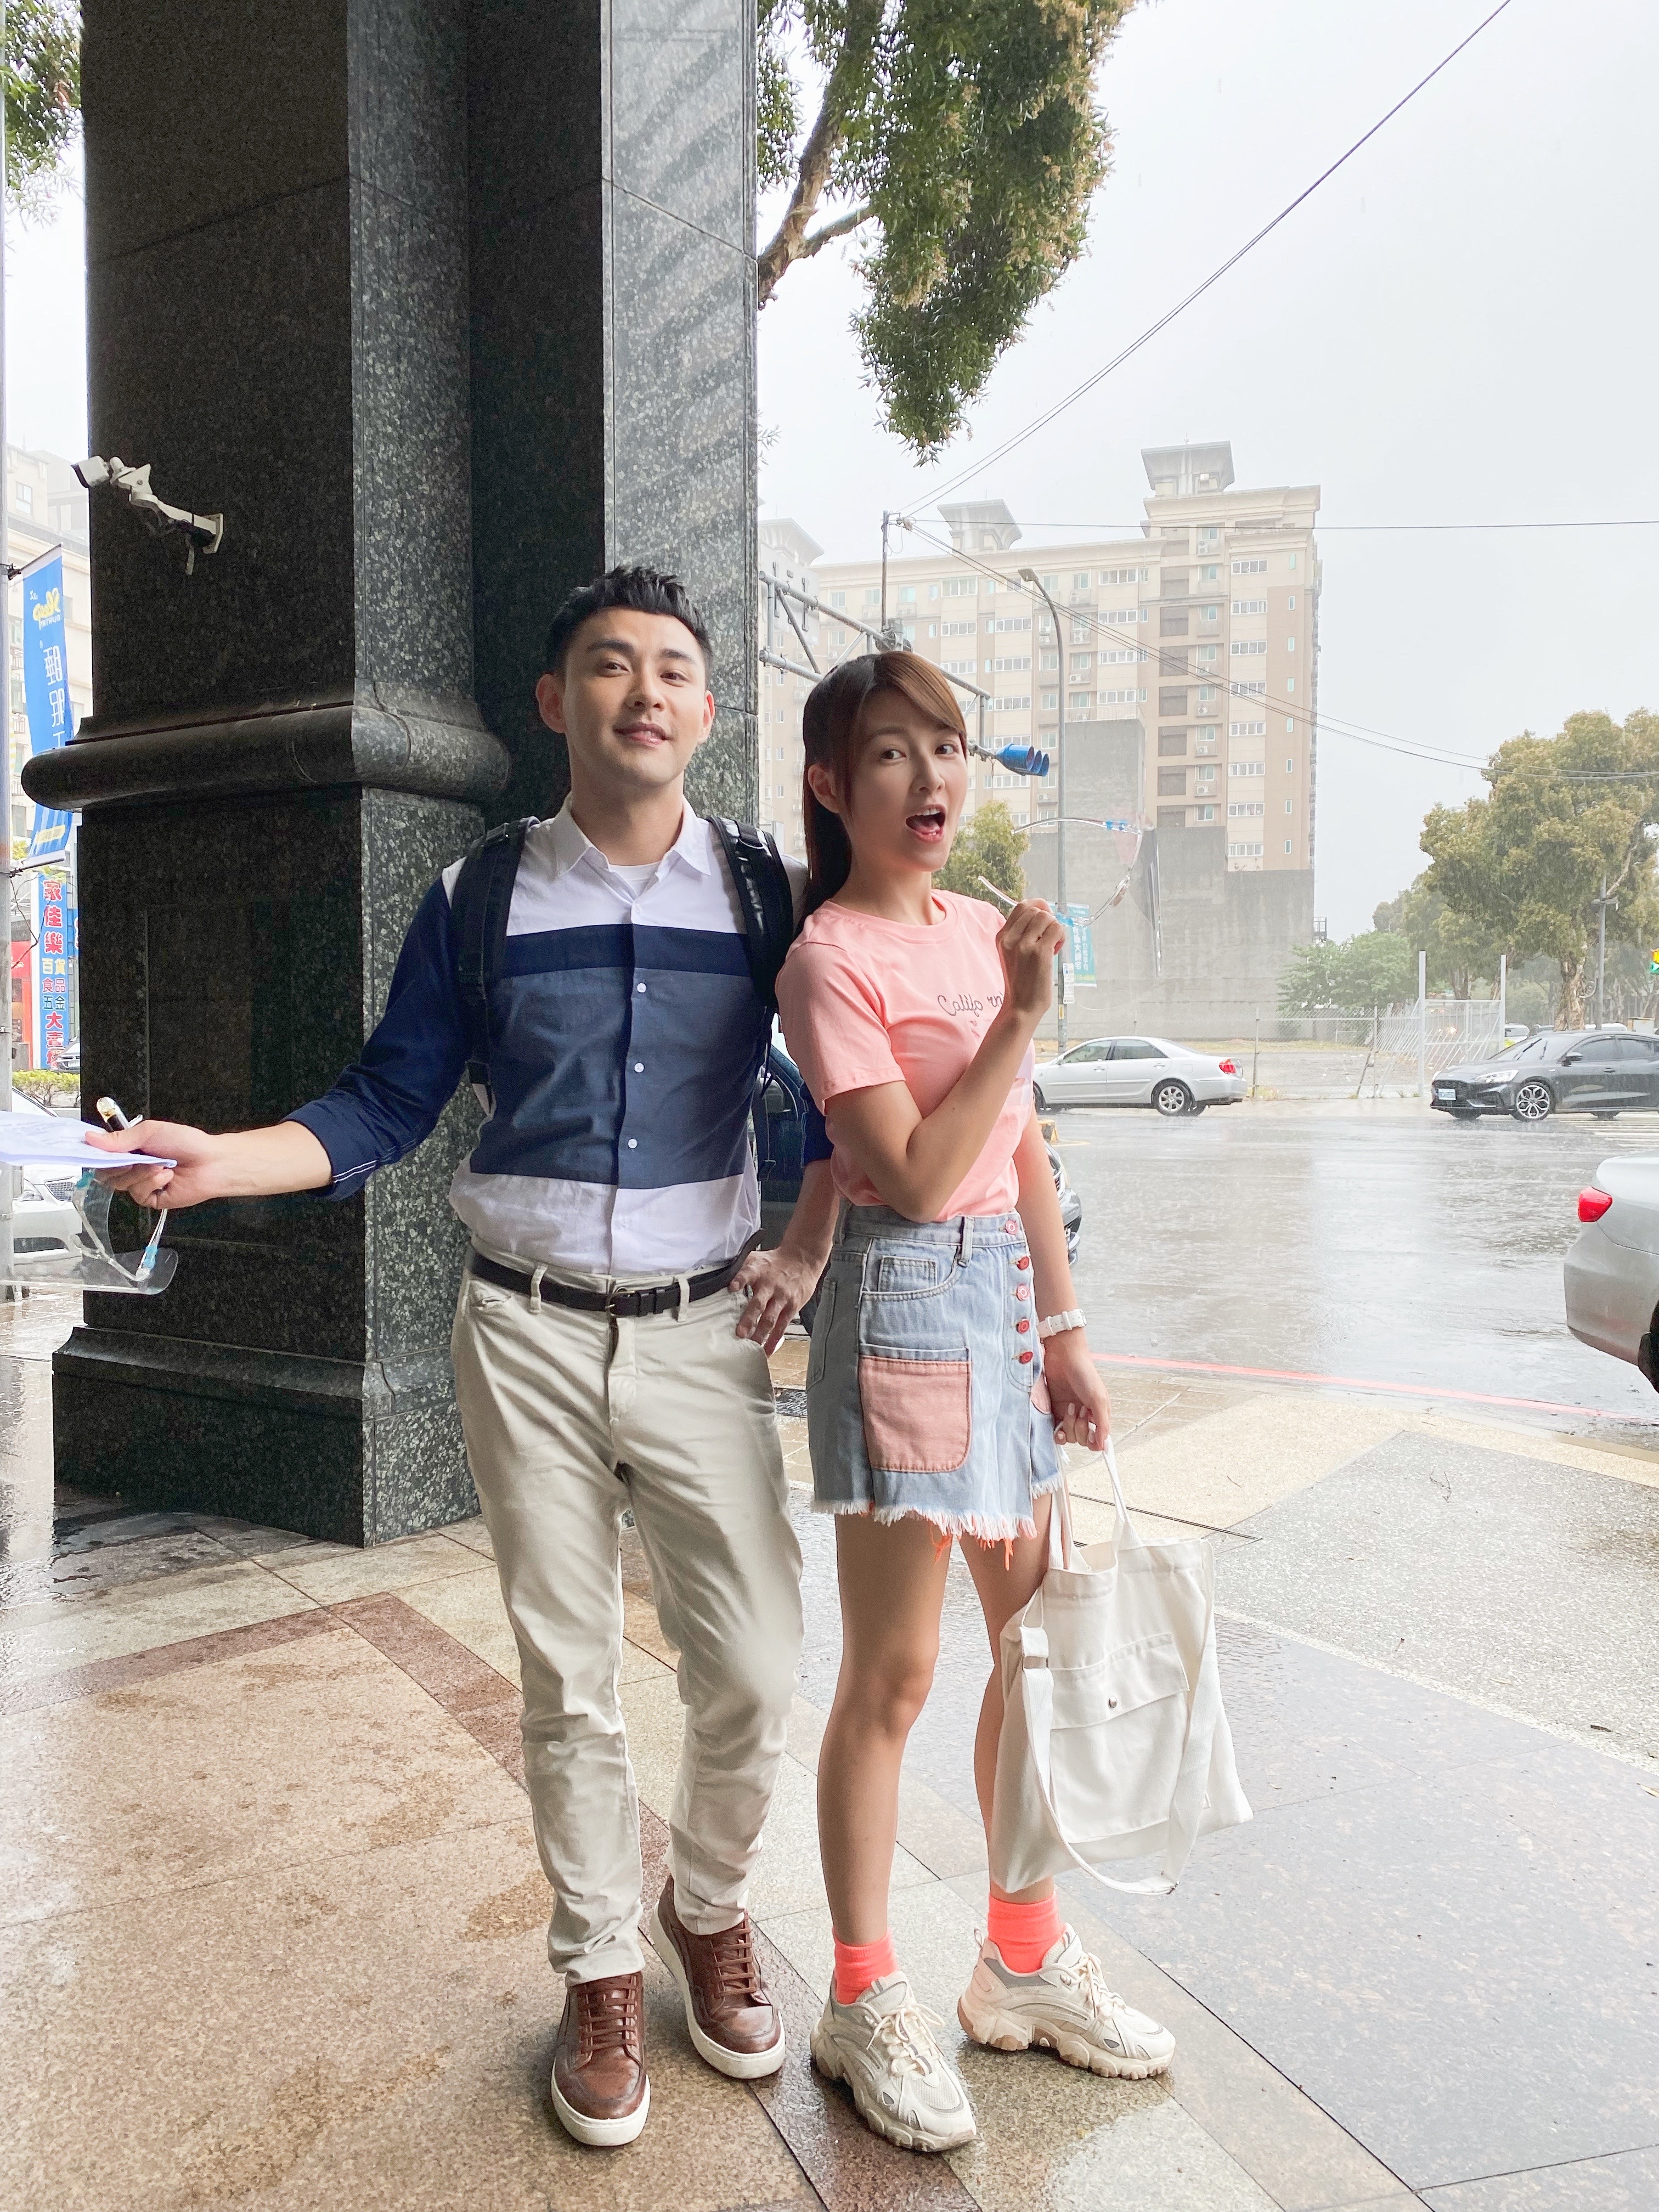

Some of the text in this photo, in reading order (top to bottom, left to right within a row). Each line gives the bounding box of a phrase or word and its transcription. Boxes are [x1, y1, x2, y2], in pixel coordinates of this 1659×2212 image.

[43, 879, 63, 954] 家佳樂
[42, 957, 65, 975] 百貨
[42, 977, 65, 993] 食品
[43, 995, 65, 1010] 五金
[937, 991, 1005, 1017] Californi
